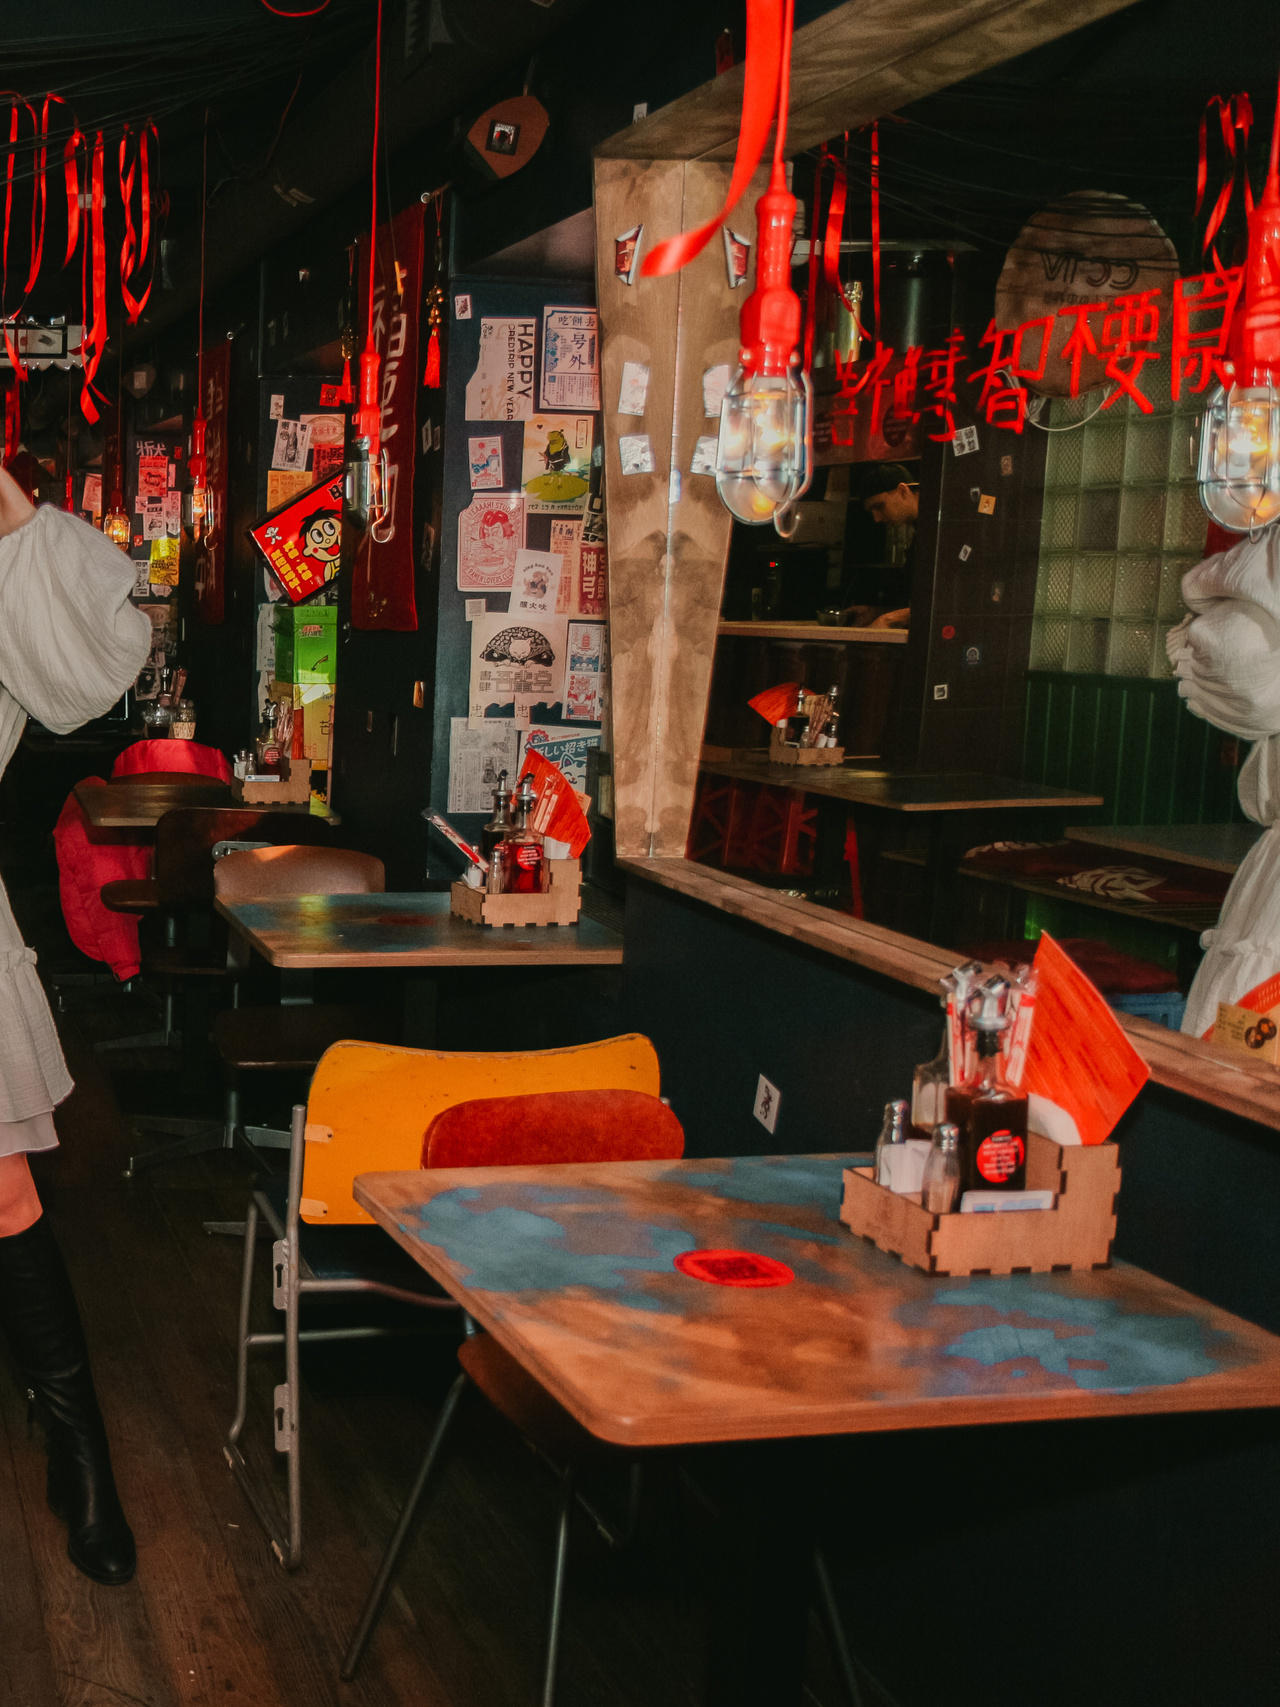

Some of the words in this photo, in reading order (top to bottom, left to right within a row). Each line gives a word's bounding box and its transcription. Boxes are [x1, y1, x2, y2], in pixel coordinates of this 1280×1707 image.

[517, 323, 533, 399] HAPPY
[568, 333, 587, 370] 号外
[506, 372, 515, 393] NEW
[506, 396, 514, 420] YEAR
[469, 502, 494, 517] YEAAAH!
